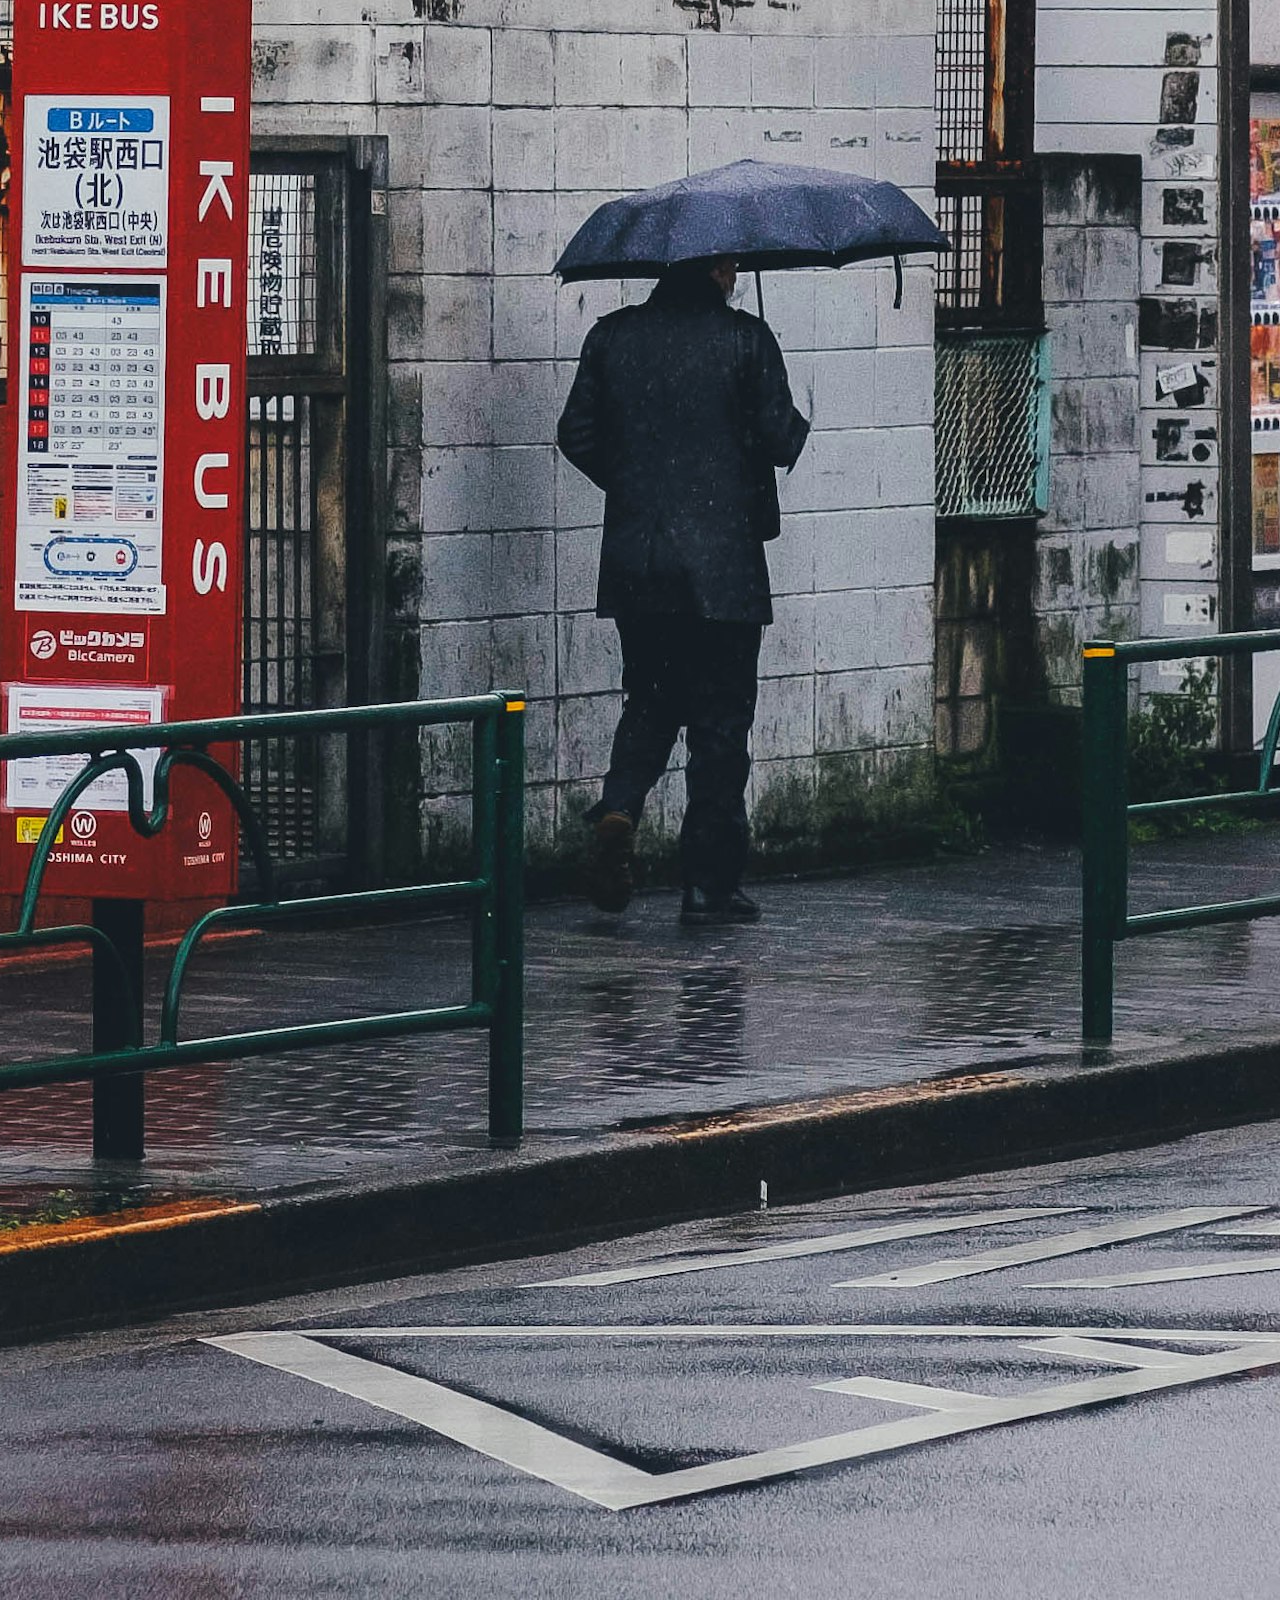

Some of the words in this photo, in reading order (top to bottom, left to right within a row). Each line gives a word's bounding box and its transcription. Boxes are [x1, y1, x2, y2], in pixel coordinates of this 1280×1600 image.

[37, 136, 164, 171] 池袋駅西口
[75, 173, 123, 209] (北)
[40, 210, 158, 231] 次は池袋駅西口(中央)
[60, 630, 144, 648] ビックカメラ
[68, 650, 135, 663] BicCamera
[100, 853, 127, 864] CITY
